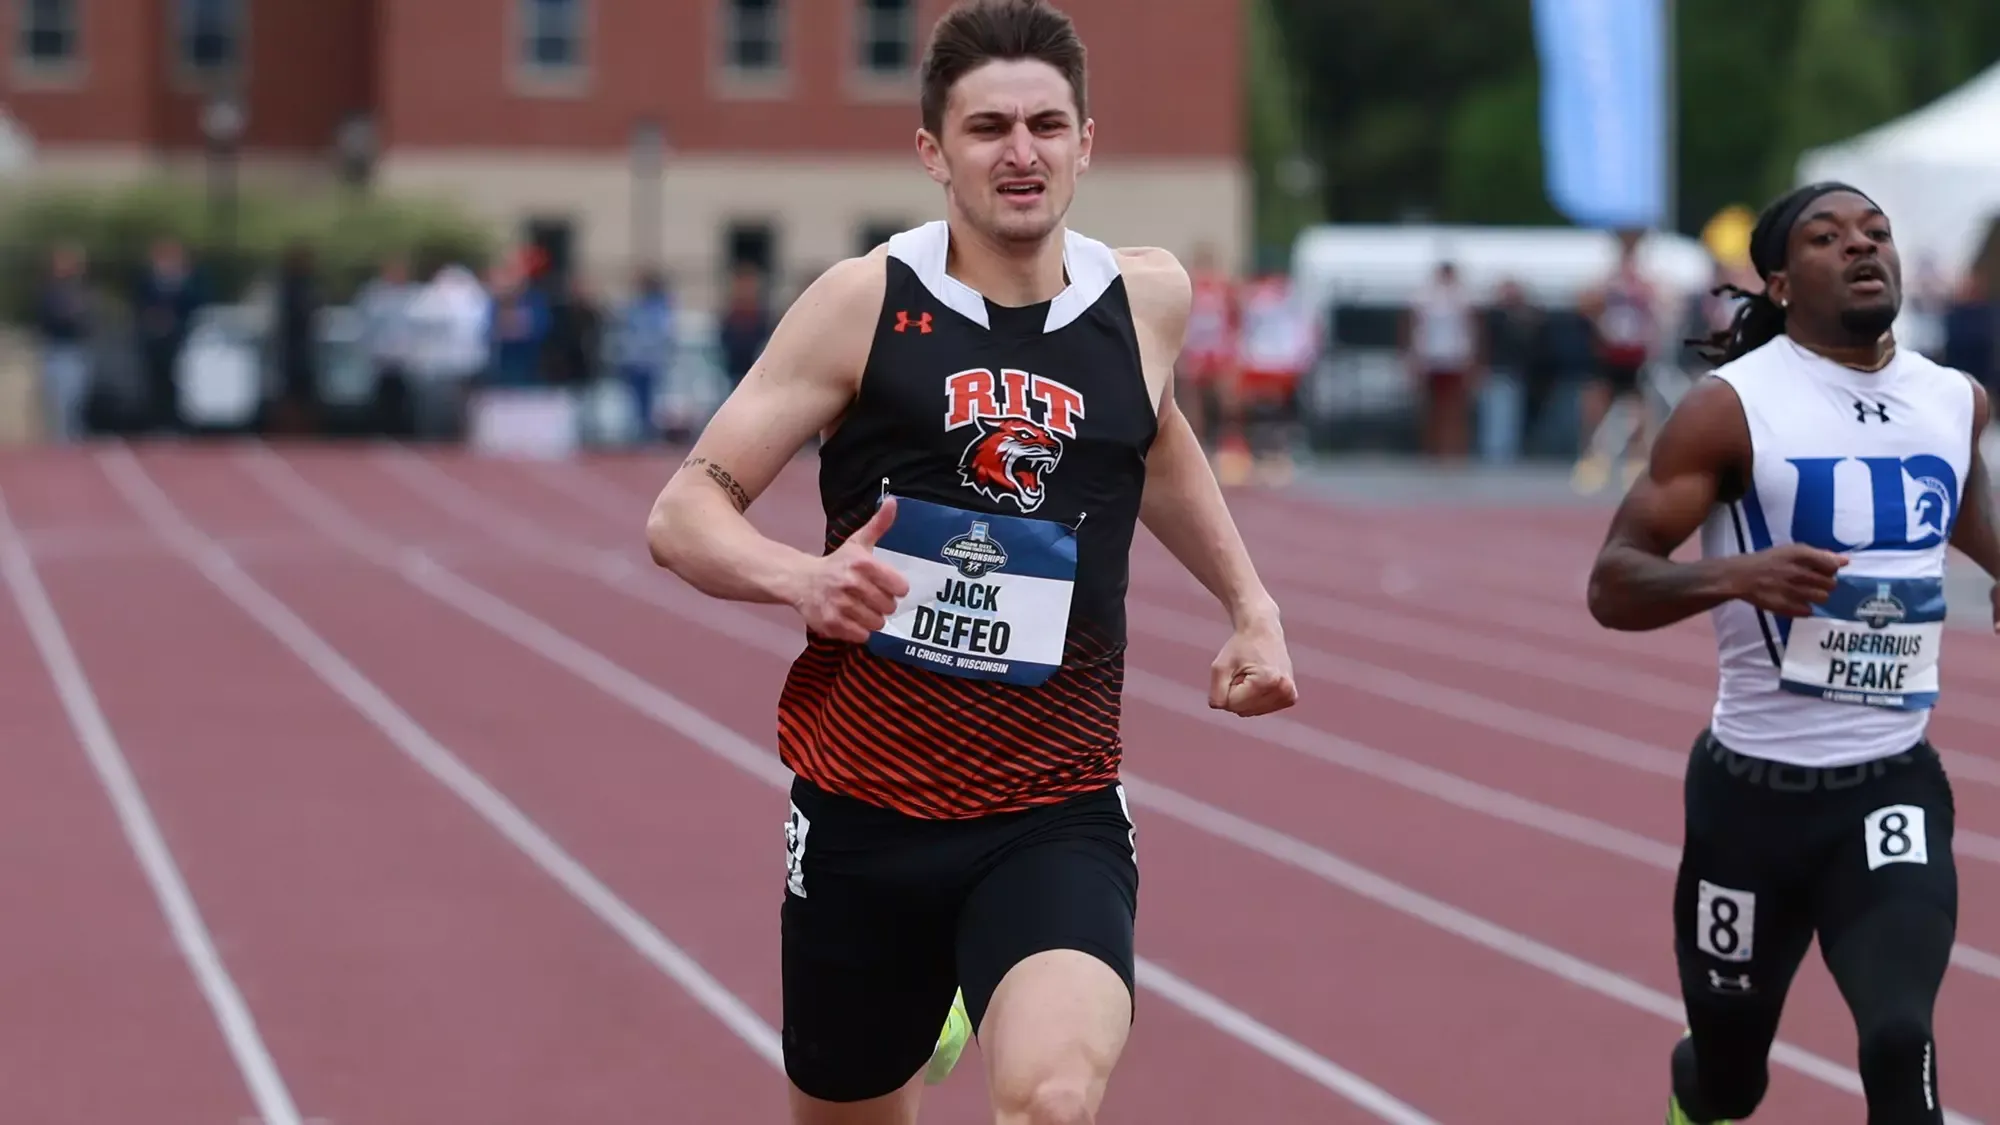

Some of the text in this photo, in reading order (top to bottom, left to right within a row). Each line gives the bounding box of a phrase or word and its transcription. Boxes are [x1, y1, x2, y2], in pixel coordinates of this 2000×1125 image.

[945, 368, 1085, 440] RIT
[943, 547, 1006, 564] CHAMPIONSHIPS
[936, 578, 1001, 611] JACK
[911, 605, 1011, 656] DEFEO
[1820, 630, 1922, 656] JABERRIUS
[904, 645, 1009, 674] LA CROSSE, WISCONSIN
[1827, 658, 1909, 690] PEAKE
[1879, 812, 1912, 857] 8
[1709, 895, 1739, 955] 8
